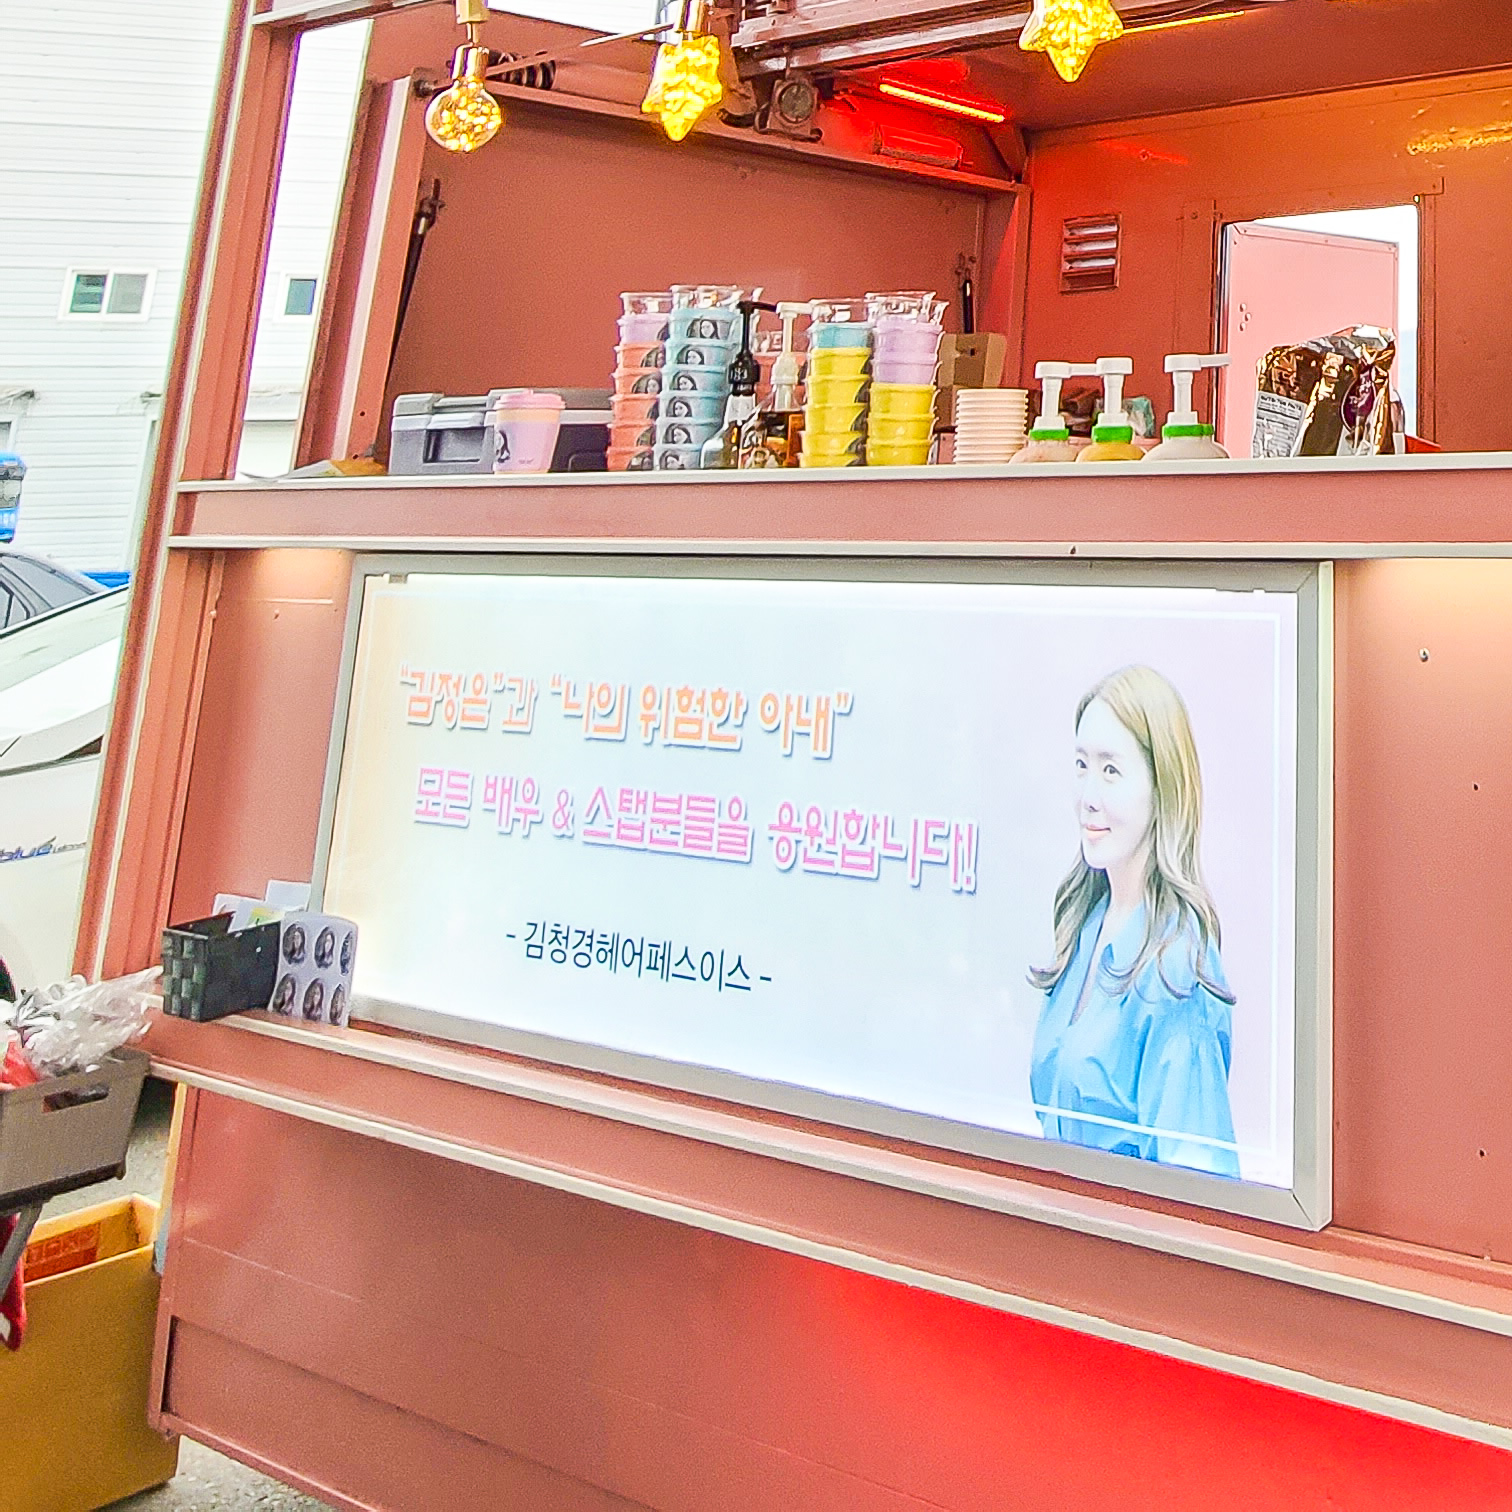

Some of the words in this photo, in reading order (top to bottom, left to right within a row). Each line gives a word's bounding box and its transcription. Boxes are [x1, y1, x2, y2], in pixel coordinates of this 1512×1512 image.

[639, 682, 746, 748] 위험한
[414, 767, 472, 825] 모든
[482, 774, 541, 835] 배우
[552, 788, 573, 836] &
[582, 786, 751, 860] 스탭분들을
[768, 800, 977, 891] 응원합니다!
